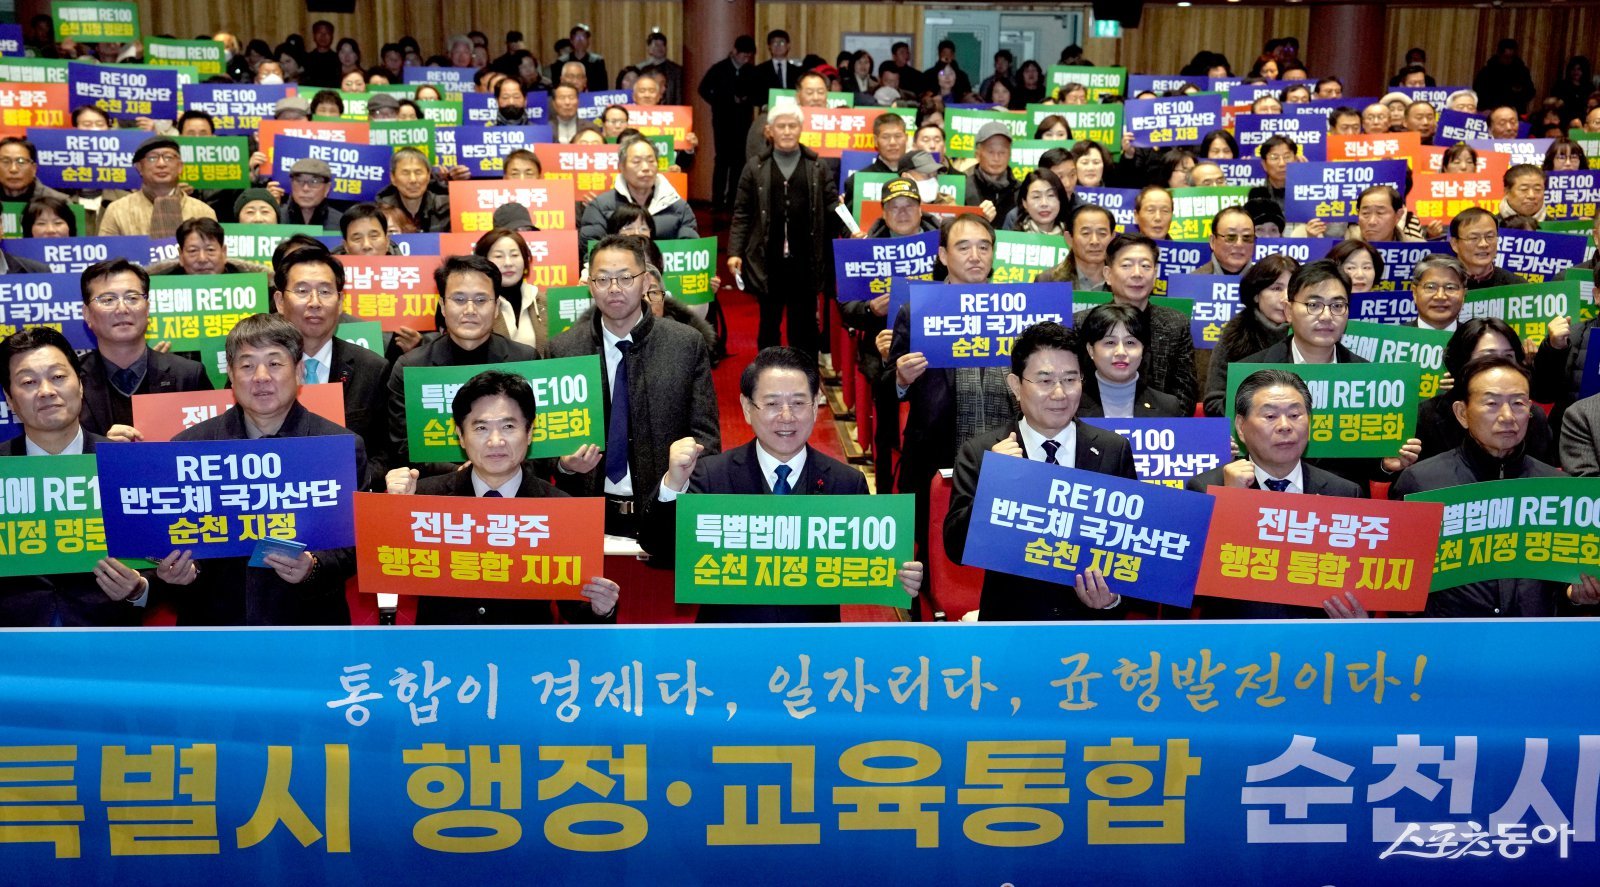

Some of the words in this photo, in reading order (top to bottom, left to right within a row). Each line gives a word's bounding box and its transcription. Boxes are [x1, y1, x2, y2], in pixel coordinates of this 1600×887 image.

[100, 8, 132, 22] RE100
[189, 46, 220, 60] RE100
[101, 72, 146, 86] RE100
[427, 71, 460, 81] RE100
[1091, 74, 1120, 87] RE100
[76, 82, 116, 98] 반도체
[119, 85, 172, 101] 국가산단
[212, 89, 256, 102] RE100
[594, 95, 627, 105] RE100
[1413, 91, 1447, 101] RE100
[126, 101, 152, 114] 지정
[424, 109, 457, 122] RE100
[1154, 101, 1193, 114] RE100
[1079, 112, 1115, 127] RE100
[1132, 116, 1166, 129] 반도체
[1169, 113, 1215, 126] 국가산단
[1261, 119, 1299, 131] RE100
[1466, 118, 1487, 132] RE1
[66, 135, 119, 150] RE100
[390, 128, 428, 144] RE100
[483, 131, 524, 144] RE100
[1150, 129, 1172, 143] 순천
[1175, 127, 1197, 140] 지정
[37, 150, 84, 165] 반도체
[87, 152, 134, 167] 국가산
[196, 146, 240, 162] RE100
[309, 145, 358, 163] RE100
[62, 168, 93, 182] 순천
[98, 167, 127, 182] 지정
[1224, 165, 1251, 177] E100
[1323, 168, 1373, 182] RE100
[333, 179, 361, 193] 지정
[1431, 181, 1491, 197] 전남·광주
[1549, 175, 1593, 189] RE100
[1294, 184, 1338, 200] 반도체
[1316, 202, 1345, 216] 순천
[1547, 204, 1567, 218] 순천
[1571, 203, 1596, 217] 지정
[534, 210, 564, 229] 지지
[1169, 220, 1198, 239] 순천
[45, 244, 107, 262] RE100
[873, 241, 926, 260] RE100
[996, 241, 1055, 267] 특별법에
[1160, 249, 1200, 264] E100
[663, 250, 709, 272] RE100
[845, 261, 891, 277] 반도체
[895, 255, 937, 274] 국가산
[533, 265, 567, 285] 지지
[682, 274, 709, 294] 문화
[196, 287, 255, 311] RE100
[357, 294, 398, 316] 통합
[960, 292, 1026, 312] RE100
[1509, 294, 1567, 319] RE100
[164, 315, 199, 339] 지정
[924, 315, 981, 336] 반도체
[952, 337, 989, 357] 순천
[1380, 339, 1443, 369] RE100
[527, 374, 587, 408] E100
[1334, 380, 1405, 409] RE100
[1339, 412, 1405, 441] 명문화
[176, 453, 281, 482] RE100
[43, 476, 100, 511] RE1
[120, 485, 212, 514] 반도체
[220, 480, 341, 511] 국가산단
[1048, 478, 1144, 520] RE100
[1441, 497, 1512, 536] 별법에
[1518, 495, 1600, 526] RE100
[55, 517, 107, 553] 명문
[168, 516, 228, 545] 순천
[238, 513, 296, 541] 지정
[411, 511, 550, 548] 전남·광주
[695, 514, 801, 550] 특별법에
[808, 516, 896, 550] RE100
[990, 498, 1074, 539] 반도체
[1080, 516, 1190, 561] 국가산단
[1256, 507, 1389, 550] 전남·광주
[1470, 536, 1518, 564] 지정
[1526, 533, 1600, 563] 명문화
[378, 544, 440, 578] 행정
[450, 551, 513, 582] 통합
[522, 554, 582, 586] 지지
[1024, 537, 1080, 571] 순천
[1086, 547, 1142, 582] 지정
[1220, 542, 1279, 581] 행정
[1287, 552, 1351, 588] 통합
[1356, 557, 1415, 591] 지지
[694, 553, 747, 586] 순천
[755, 556, 808, 587] 지정
[815, 556, 896, 588] 명문화
[326, 660, 499, 726] 통합이
[532, 658, 737, 723] 경제다,
[769, 654, 1022, 720] 일자리다,
[1050, 649, 1428, 713] 균형발전이다!
[402, 740, 1202, 853] 행정·교육통합
